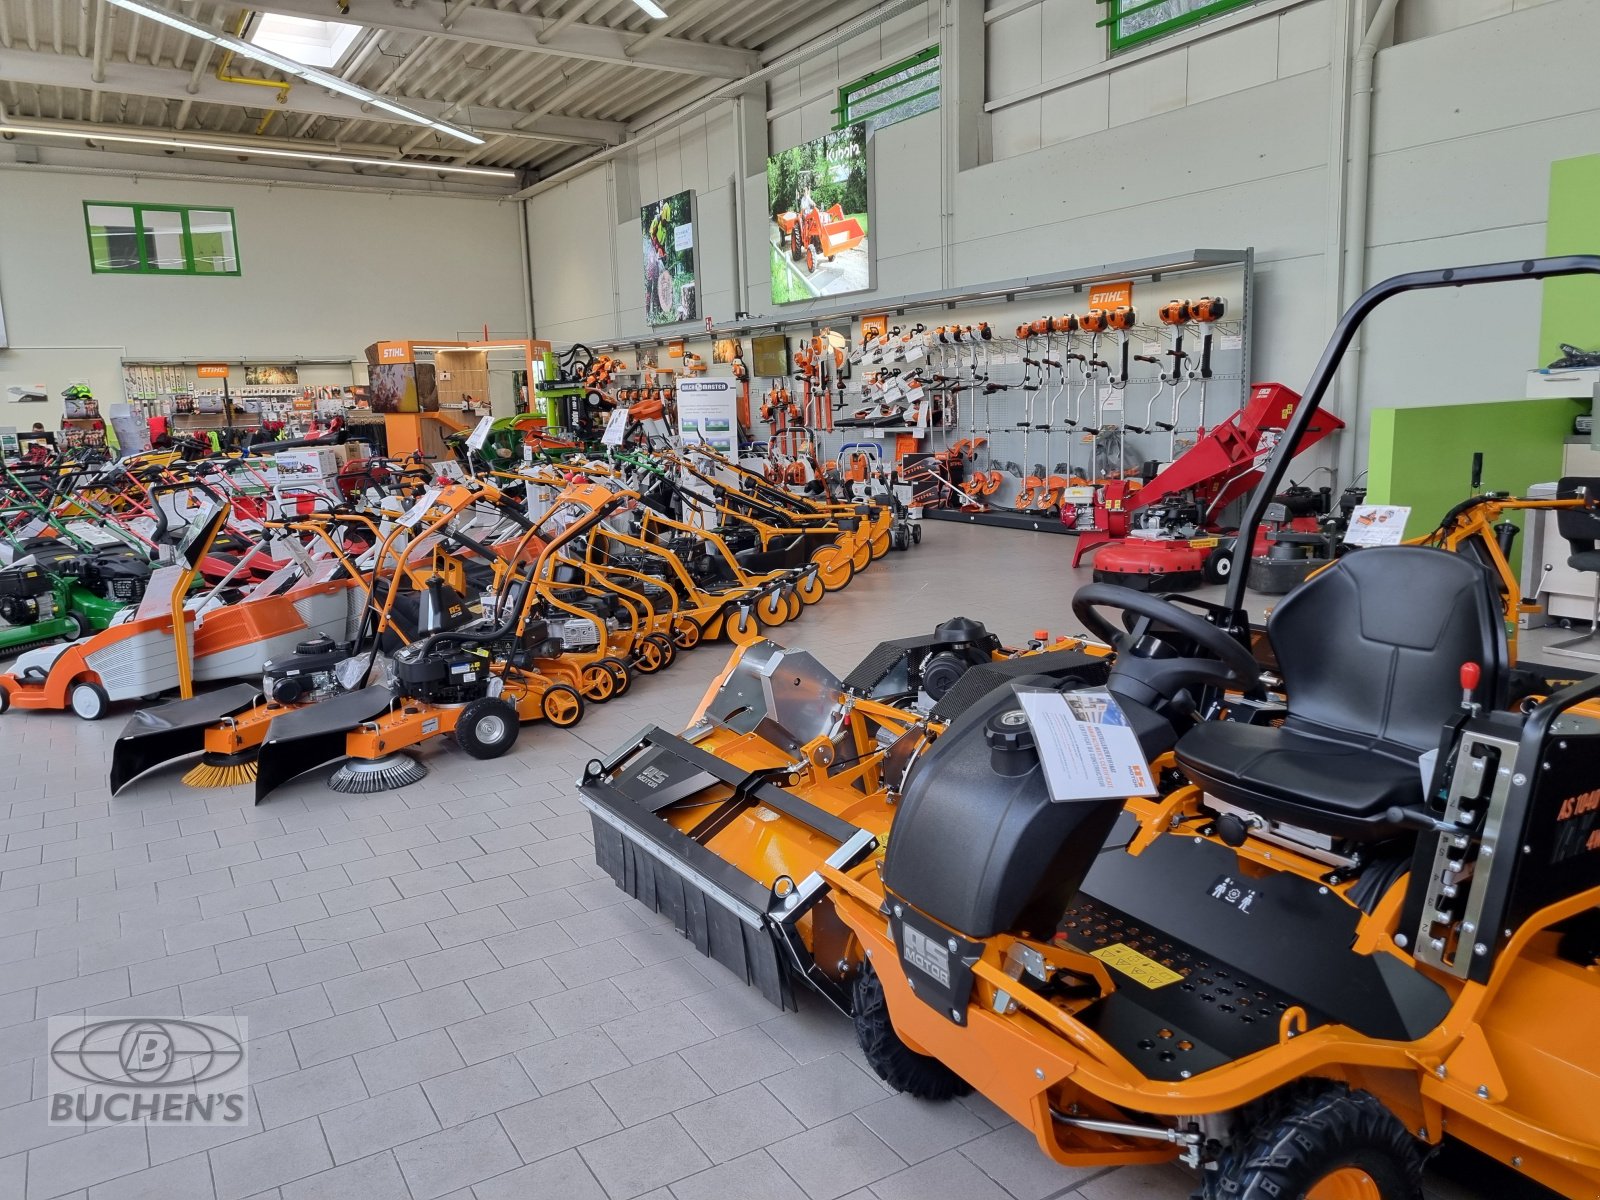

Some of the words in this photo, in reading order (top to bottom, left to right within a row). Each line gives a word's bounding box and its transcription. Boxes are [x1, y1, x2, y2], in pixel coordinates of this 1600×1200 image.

[826, 142, 860, 161] Kubota
[1092, 291, 1124, 304] STIHL
[384, 347, 404, 358] STIHL
[903, 465, 926, 476] STIHL
[636, 774, 659, 789] MOTOR
[642, 766, 670, 784] AS
[904, 925, 948, 971] AS
[905, 948, 948, 983] MOTOR
